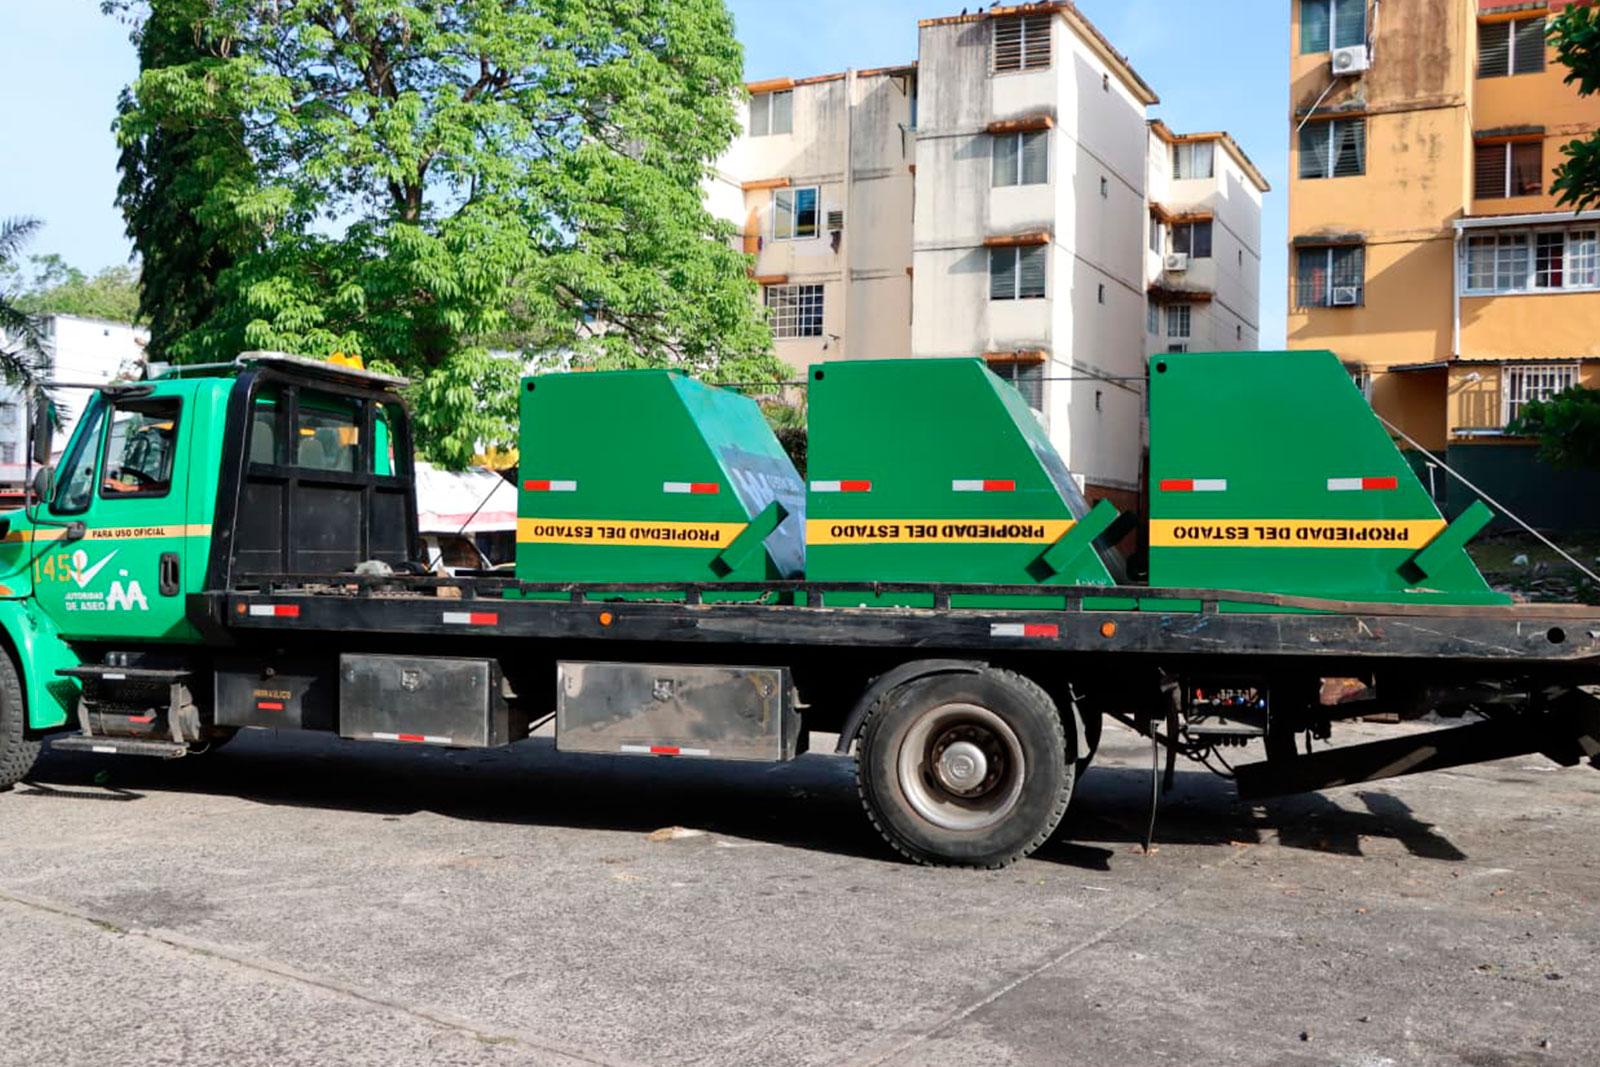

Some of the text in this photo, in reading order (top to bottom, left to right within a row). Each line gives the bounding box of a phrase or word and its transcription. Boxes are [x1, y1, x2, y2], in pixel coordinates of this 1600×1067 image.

[92, 527, 165, 538] PARA USO OFICIAL
[533, 522, 720, 542] PROPIEDAD DEL ESTADO
[830, 524, 1045, 539] PROPIEDAD DEL ESTADO
[1173, 526, 1409, 541] PROPIEDAD DEL ESTADO
[65, 602, 106, 611] DE ASEO
